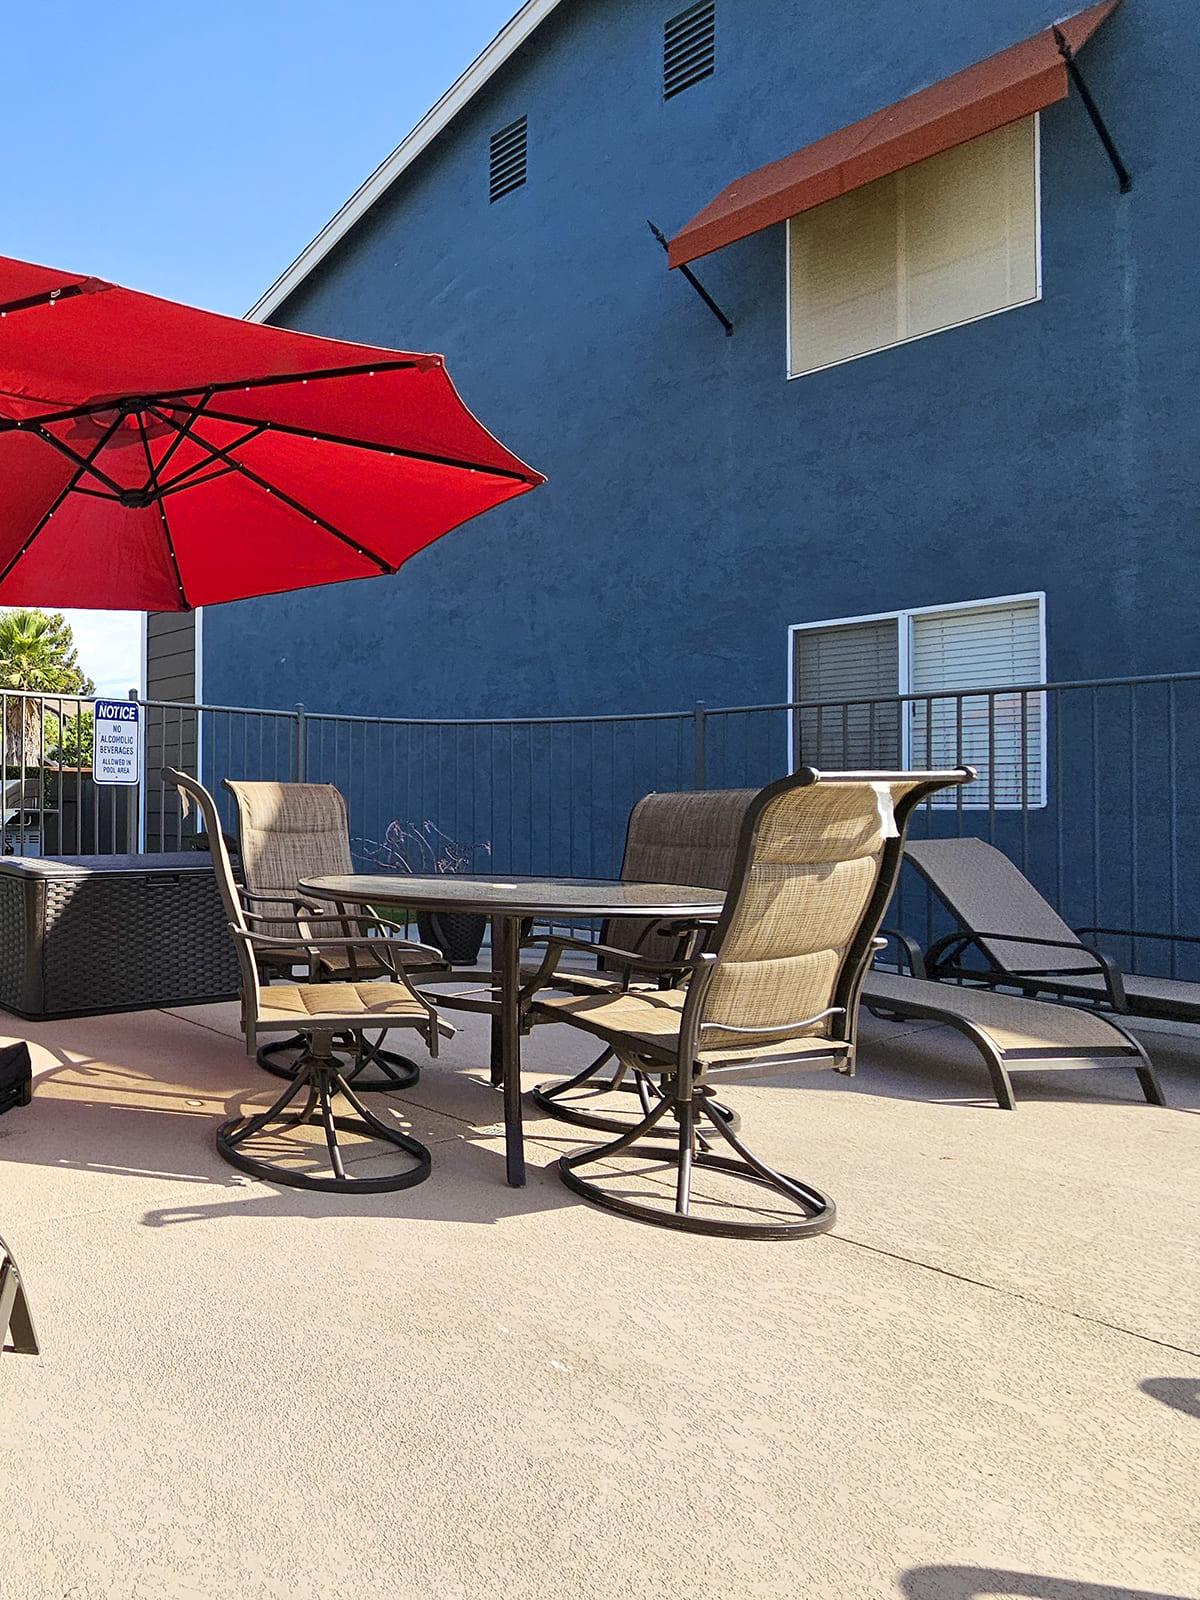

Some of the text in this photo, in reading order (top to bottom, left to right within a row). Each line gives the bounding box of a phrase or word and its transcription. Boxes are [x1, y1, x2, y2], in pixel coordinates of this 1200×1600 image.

[98, 705, 136, 720] NOTICE
[113, 725, 121, 733] NO
[100, 735, 134, 744] ALCOHOLIC
[99, 745, 134, 755] BEVERAGES
[102, 758, 126, 766] ALLOWED
